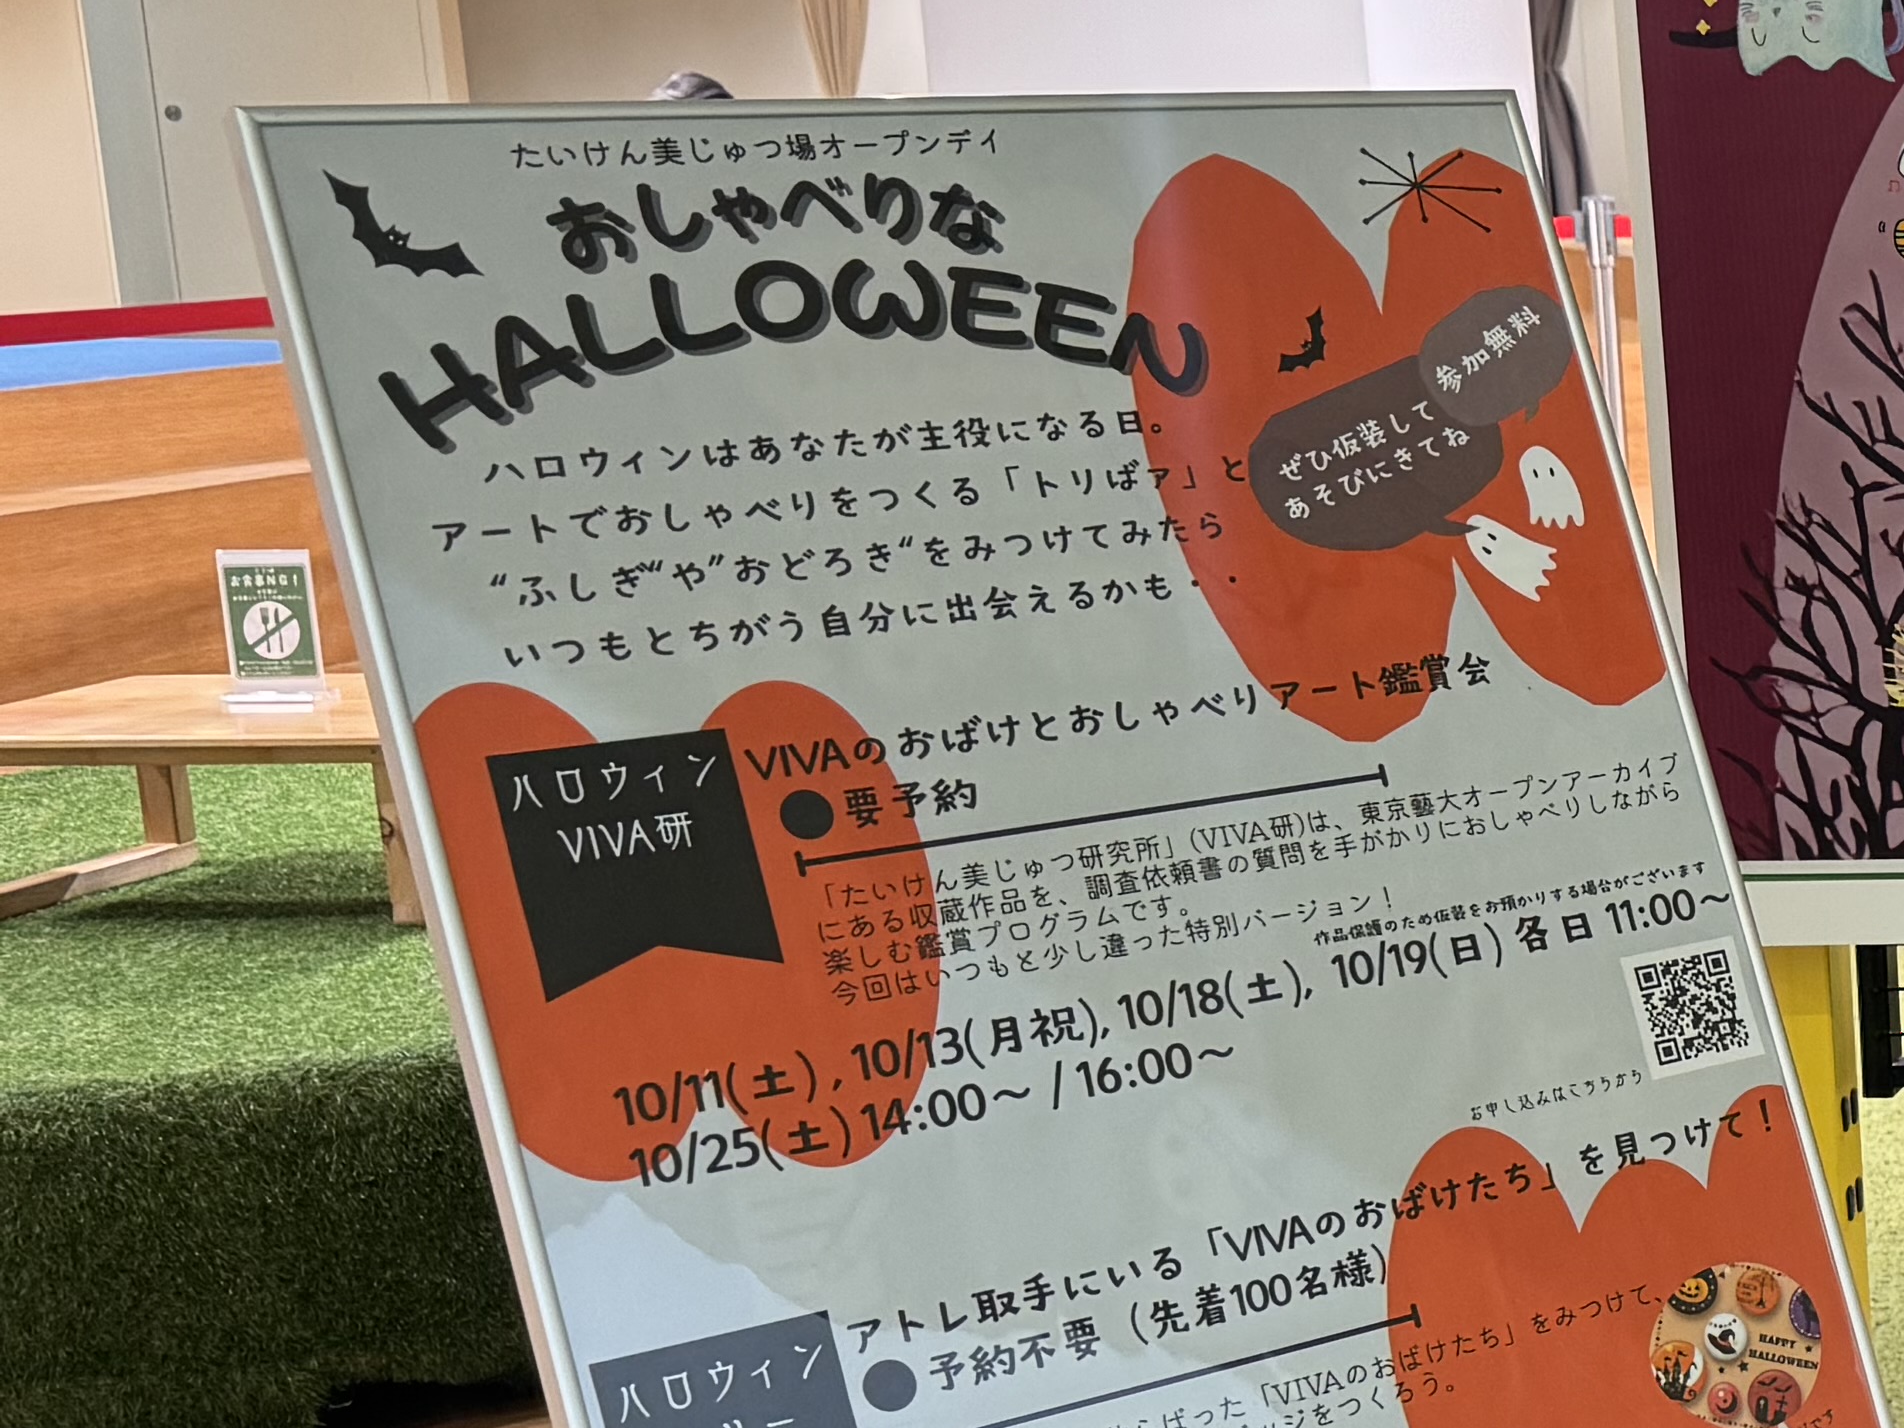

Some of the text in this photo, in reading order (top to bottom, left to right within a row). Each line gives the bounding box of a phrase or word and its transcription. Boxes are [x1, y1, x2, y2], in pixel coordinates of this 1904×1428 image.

[512, 129, 1000, 171] たいけん美じゅつ場オープンデイ
[546, 172, 1008, 272] おしゃべりな
[378, 259, 1209, 454] HALLOWEEN
[1435, 304, 1543, 394] 参加無料
[483, 408, 1167, 485] ハロウィンはあなたが主役になる日。
[1279, 400, 1438, 482] ぜひ仮装して
[1284, 425, 1472, 521] あそびにきてね
[745, 650, 1491, 780] VIVAのおばけとおしゃべりアート鑑賞会
[511, 752, 718, 812] ハロウィン
[844, 778, 978, 829] 要予約
[556, 811, 694, 865] VIVA研
[824, 894, 1190, 975] 楽しむ鑑賞プログラムです。
[1330, 922, 1503, 990] 10/19(日)
[1515, 912, 1594, 955] 各日
[1471, 1070, 1642, 1121] お申し込みはこちらから
[628, 1106, 852, 1187] 10/25(土)
[619, 1341, 825, 1423] ハロウィン
